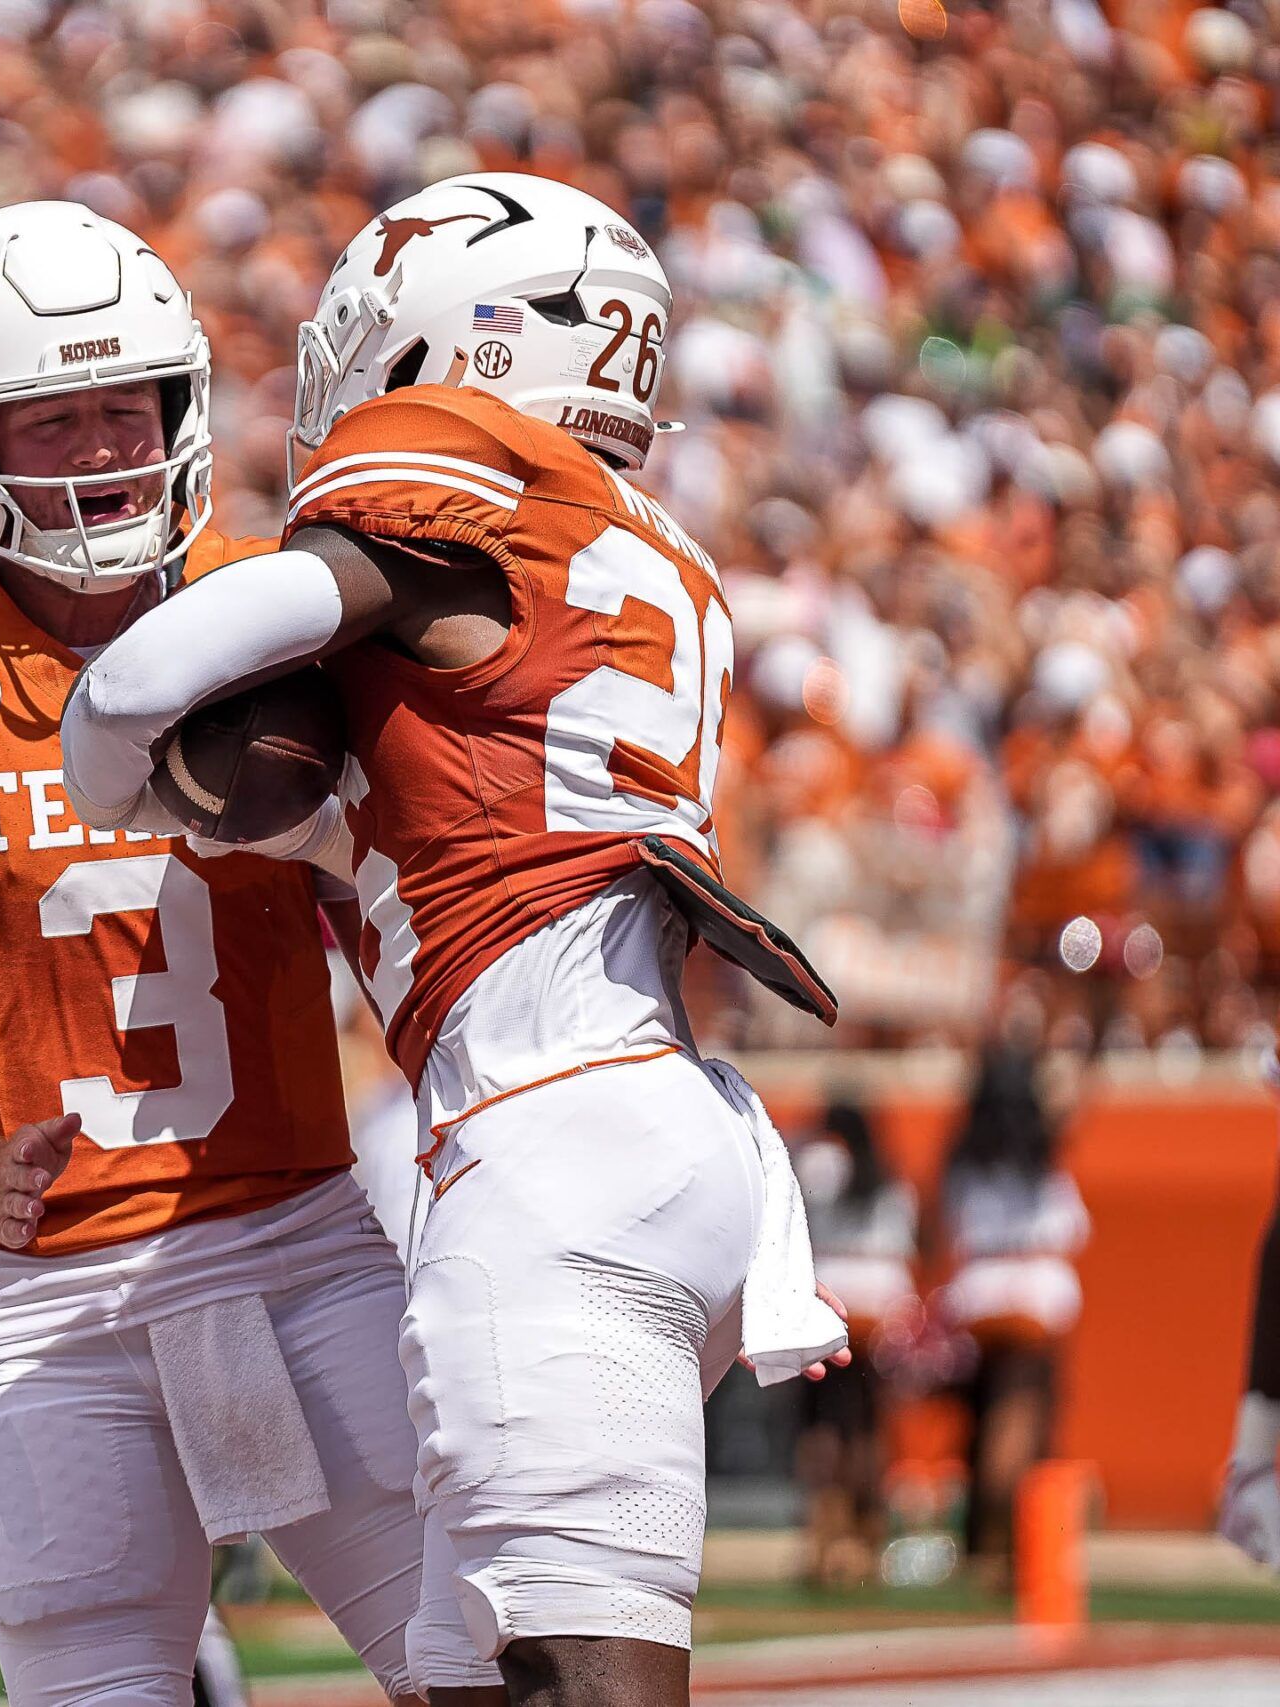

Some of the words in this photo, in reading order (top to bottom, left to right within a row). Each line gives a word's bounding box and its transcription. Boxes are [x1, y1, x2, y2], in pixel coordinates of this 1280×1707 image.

[59, 337, 121, 364] HORNS
[475, 341, 511, 378] SEC
[586, 299, 662, 403] 26
[39, 854, 235, 1150] 3
